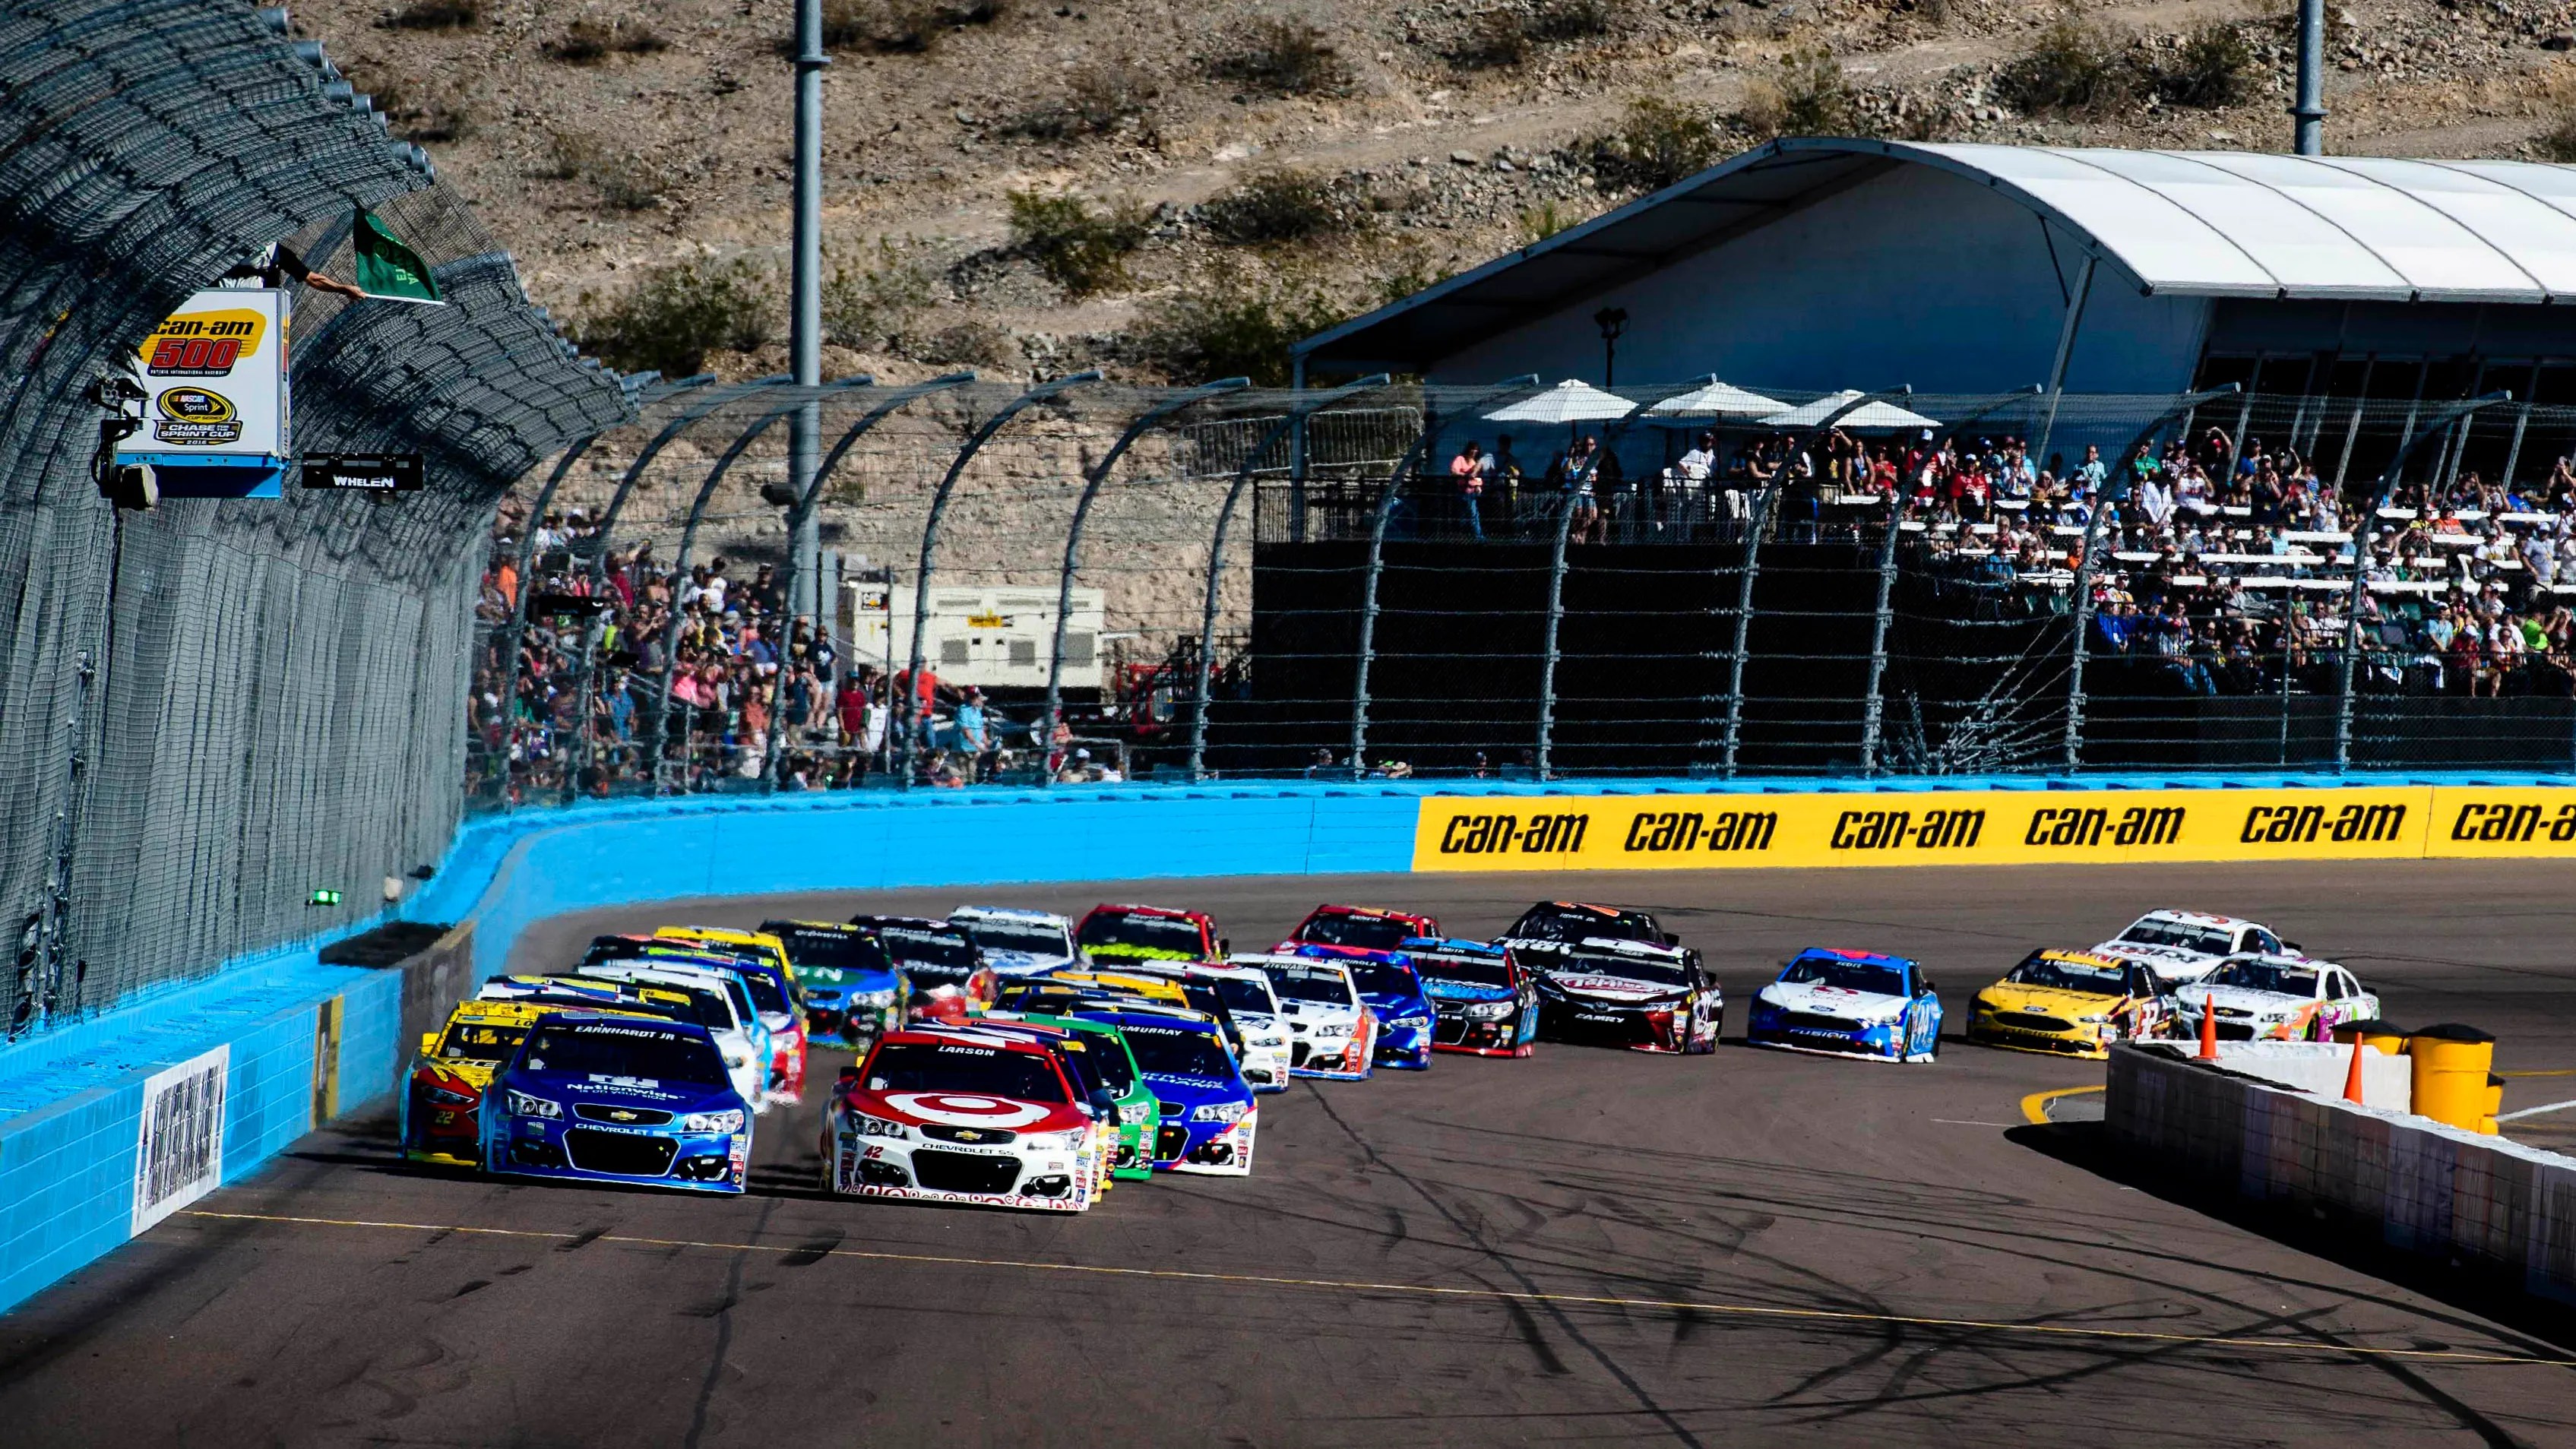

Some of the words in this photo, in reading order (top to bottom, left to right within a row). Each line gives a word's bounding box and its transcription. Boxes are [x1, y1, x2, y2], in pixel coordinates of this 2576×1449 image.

[153, 321, 255, 335] can-am
[152, 338, 242, 369] 500
[185, 403, 208, 412] Sprint
[333, 474, 394, 487] WHELEN
[1831, 808, 1986, 849] can-am
[2025, 806, 2185, 846] can-am
[2240, 804, 2406, 843] can-am
[2451, 803, 2576, 841] can-a
[1441, 814, 1588, 853] can-am
[1625, 811, 1777, 852] can-am
[1574, 1013, 1625, 1023] CAMRY
[574, 1026, 657, 1038] EARNHARDT
[659, 1032, 676, 1041] JR
[938, 1046, 995, 1056] LARSON
[567, 1083, 679, 1099] Nationwide
[435, 1111, 454, 1125] 22
[575, 1123, 647, 1136] CHEVROLET
[864, 1146, 884, 1159] 42
[922, 1143, 993, 1155] CHEVROLET
